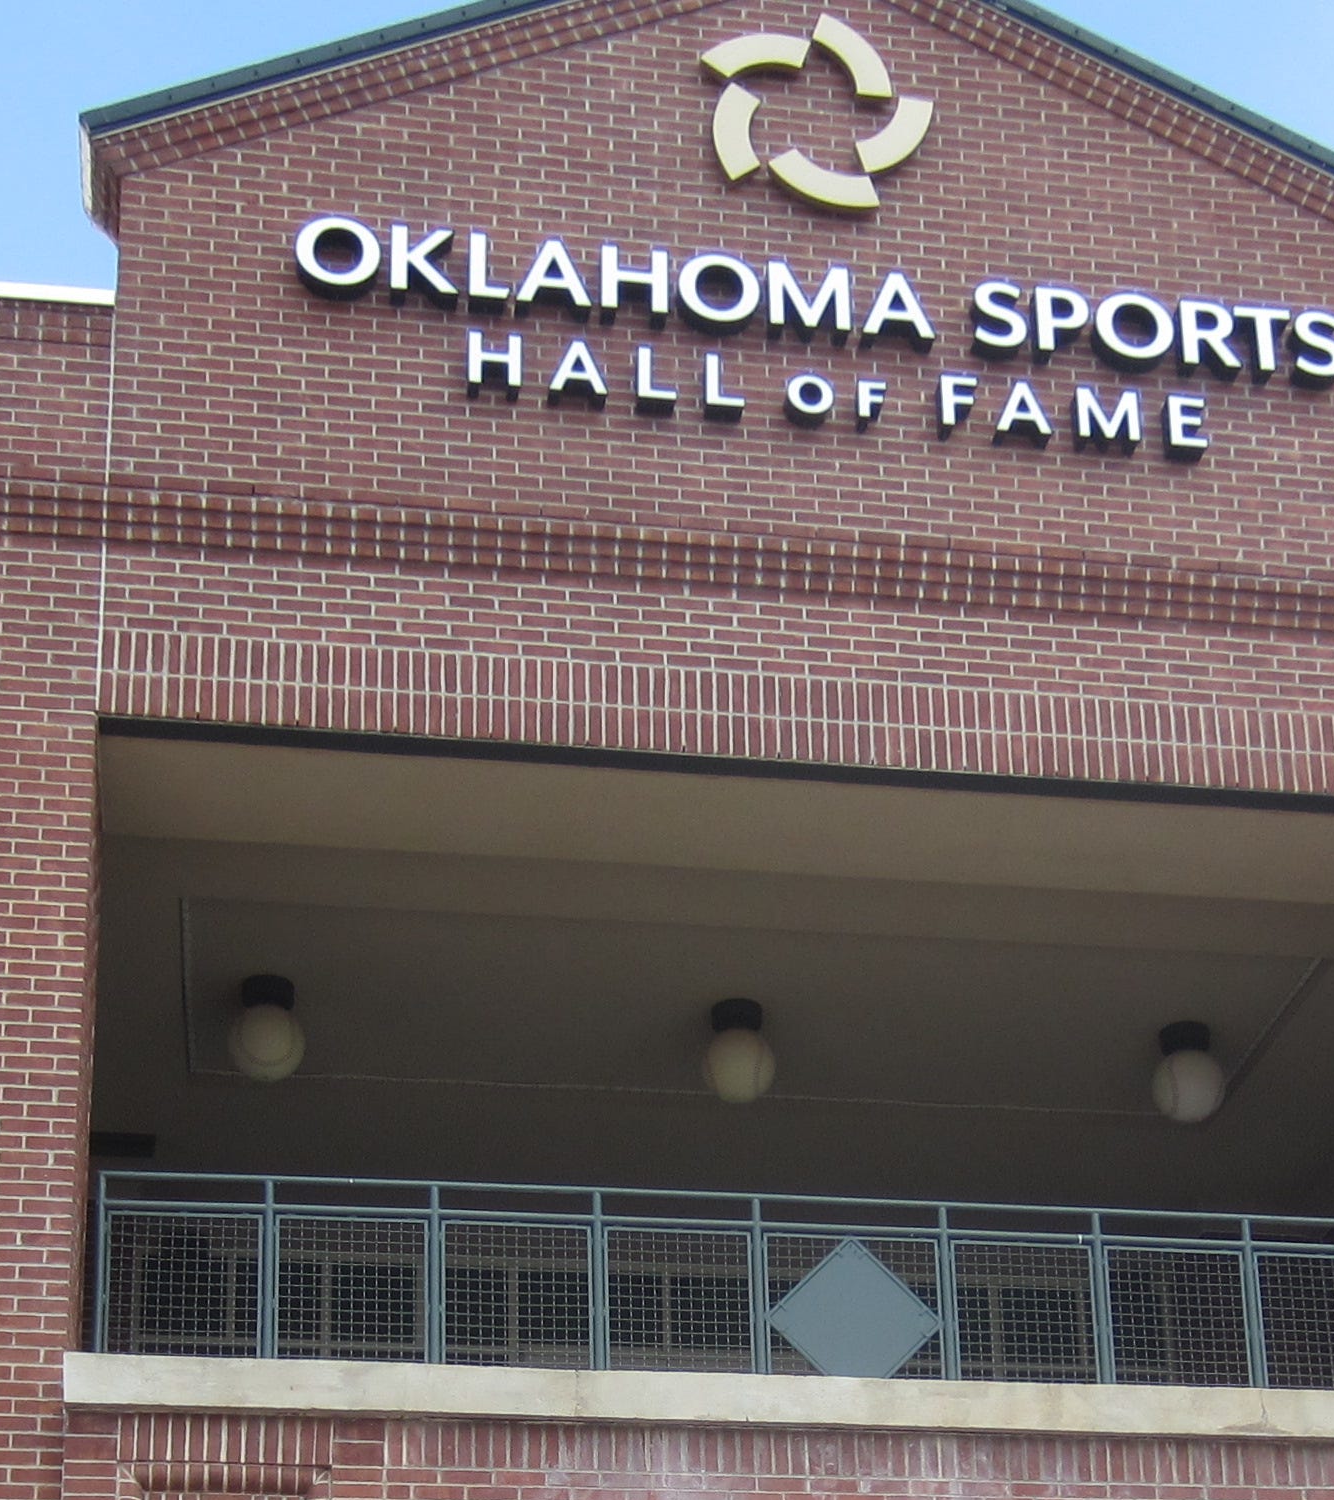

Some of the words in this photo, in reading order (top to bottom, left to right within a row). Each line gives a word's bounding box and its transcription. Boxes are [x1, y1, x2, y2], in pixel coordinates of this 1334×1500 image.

[294, 216, 935, 341] OKLAHOMA
[467, 331, 745, 412] HALL
[785, 375, 887, 424] OF
[939, 373, 1209, 458] FAME
